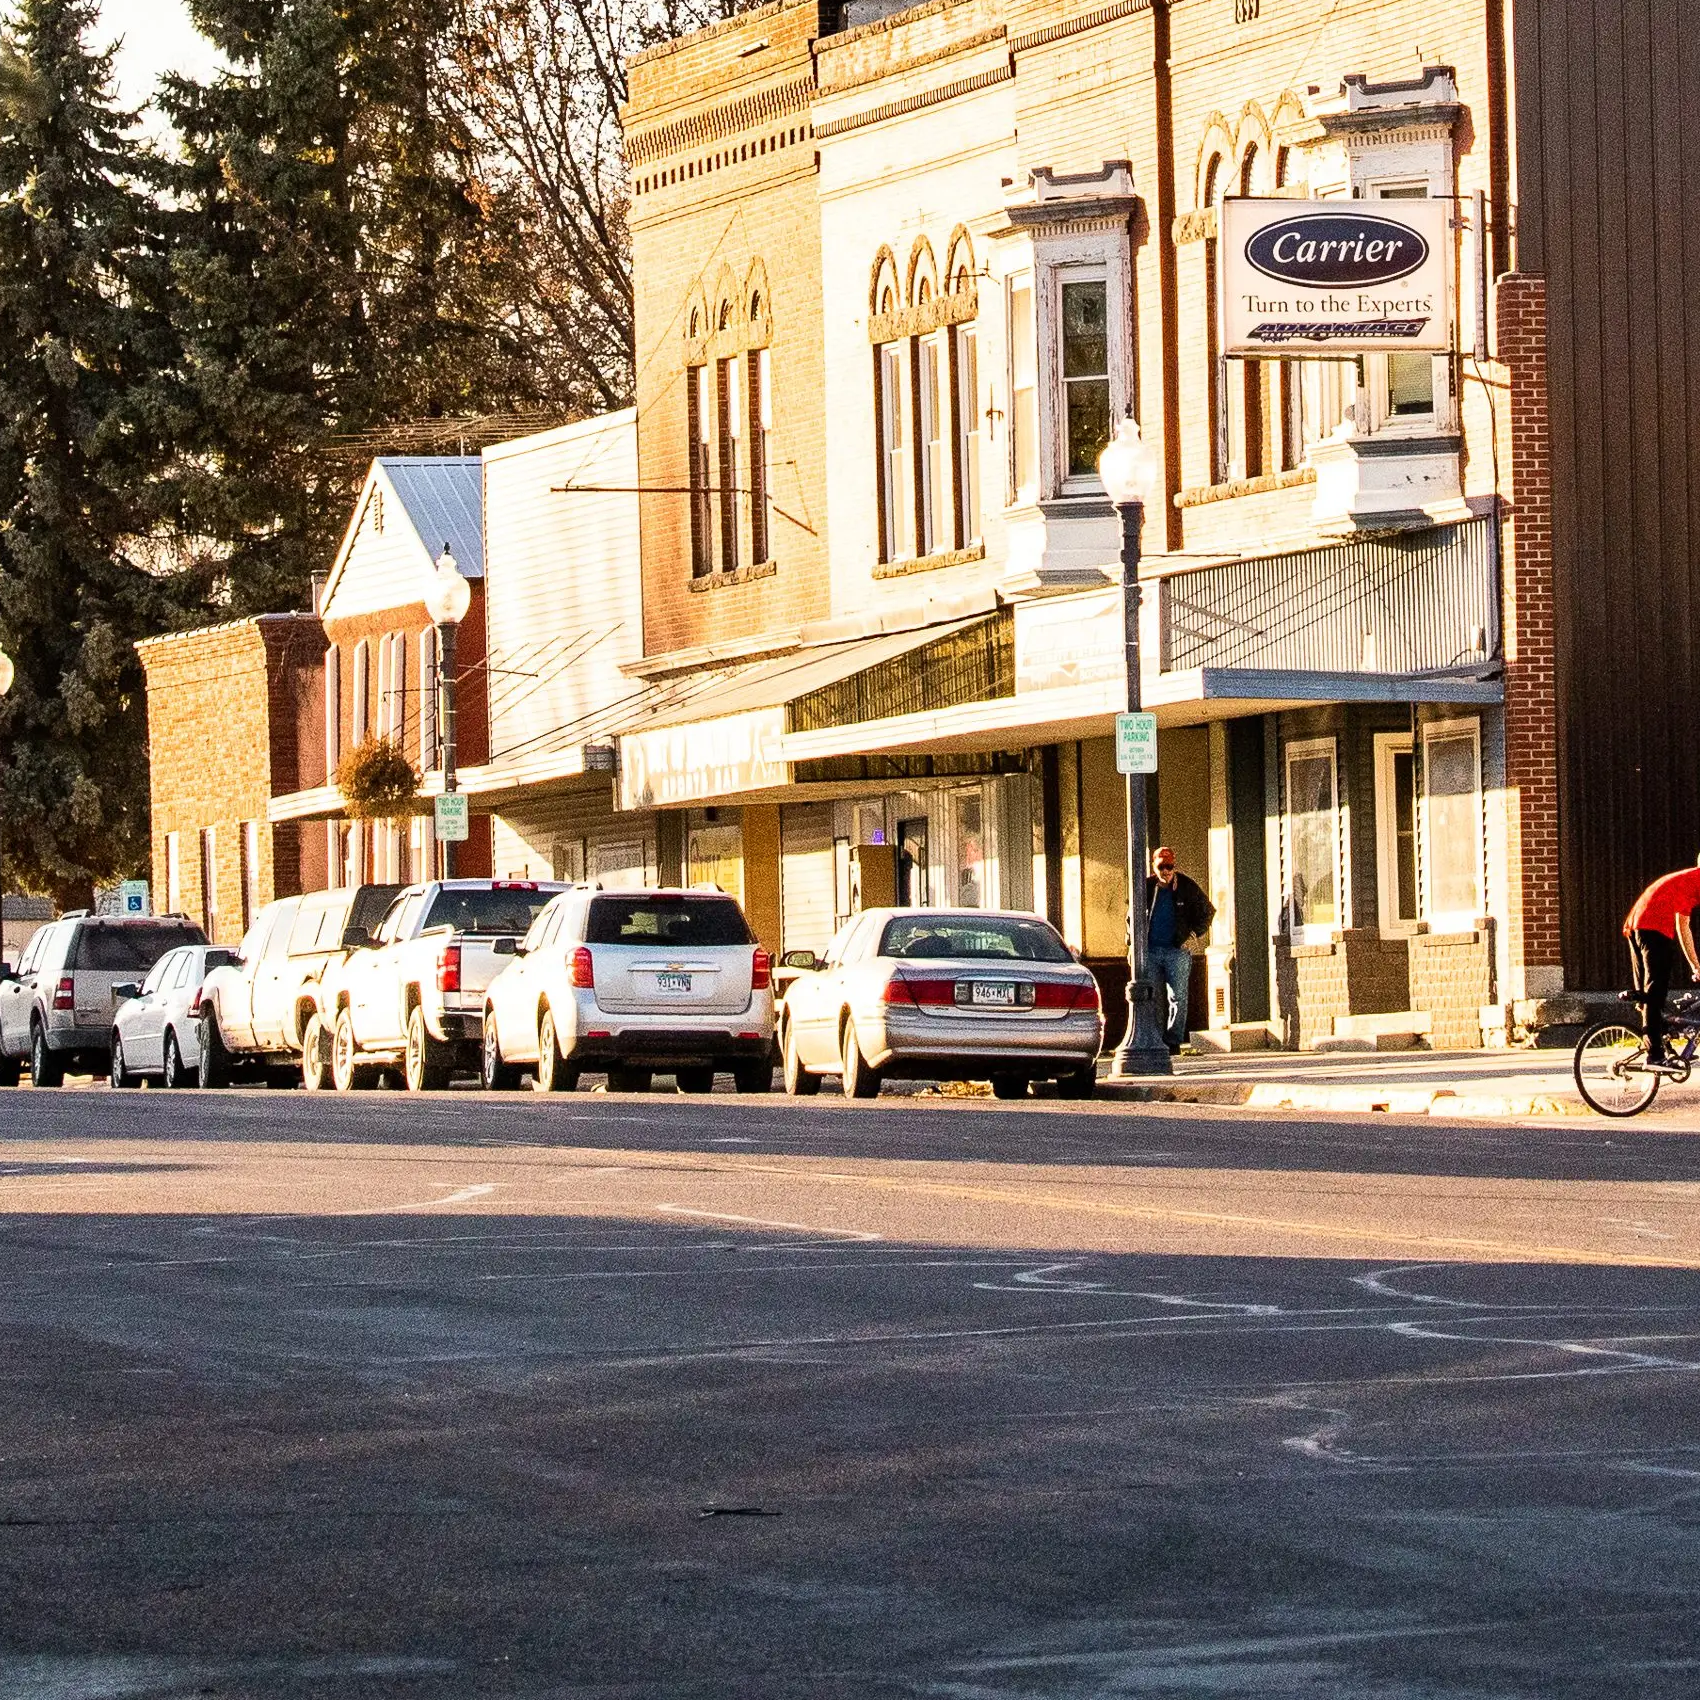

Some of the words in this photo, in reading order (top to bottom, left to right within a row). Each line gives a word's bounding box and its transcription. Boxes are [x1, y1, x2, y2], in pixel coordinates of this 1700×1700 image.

[1272, 232, 1403, 263] Carrier
[1242, 295, 1288, 312] Turn
[1296, 298, 1314, 312] to
[1321, 294, 1350, 312] the
[1257, 322, 1422, 333] ADVANTAGE
[1120, 719, 1133, 730] TWO
[1136, 719, 1152, 730] HOUR
[1124, 732, 1149, 742] PARKING
